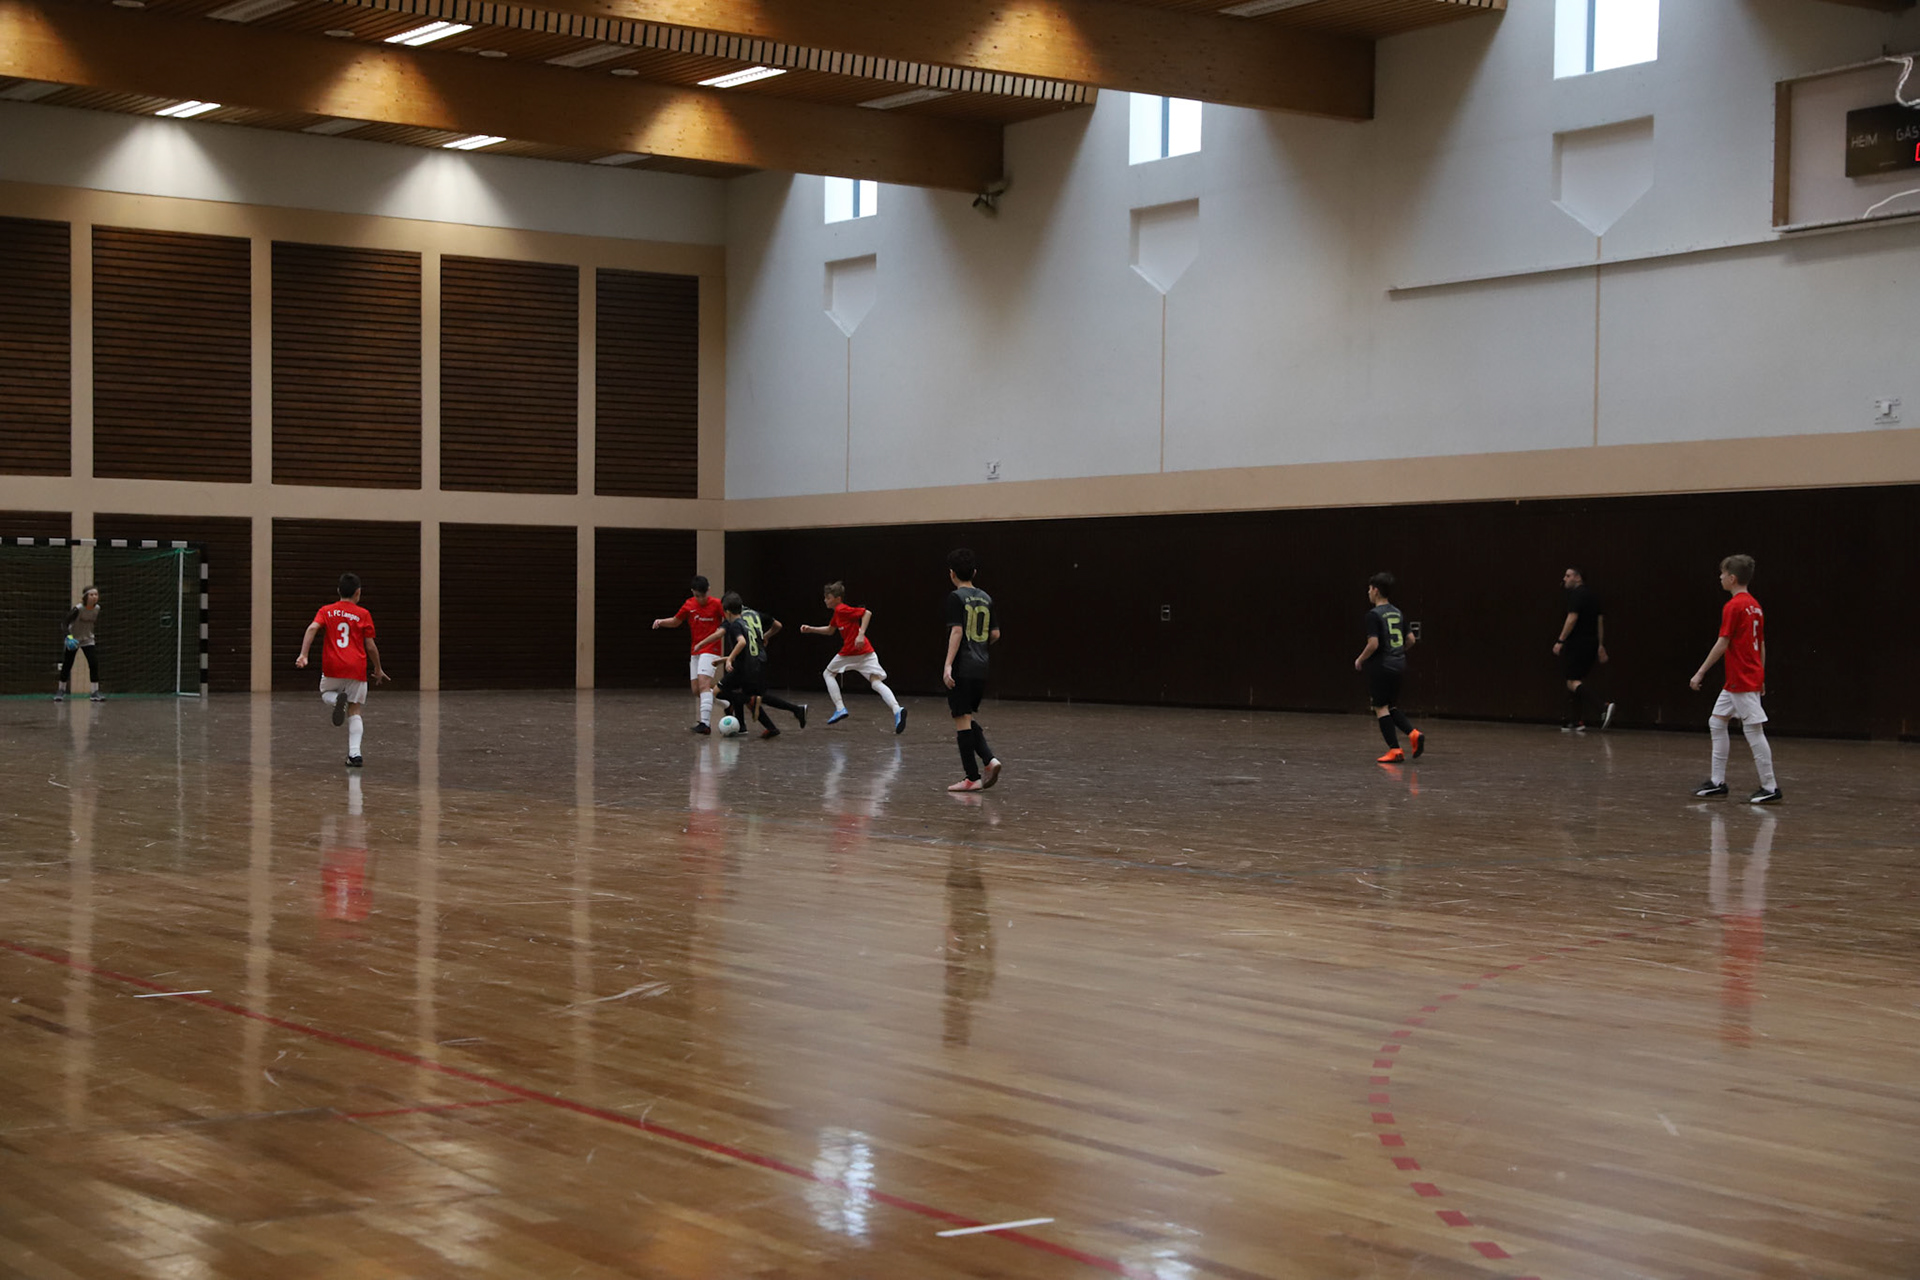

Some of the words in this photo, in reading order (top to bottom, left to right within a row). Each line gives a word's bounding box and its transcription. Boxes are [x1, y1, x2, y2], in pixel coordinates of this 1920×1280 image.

[1851, 132, 1878, 148] HEIM
[1896, 124, 1920, 142] GAS
[333, 609, 341, 617] FC
[964, 603, 990, 642] 10
[336, 622, 350, 648] 3
[1387, 617, 1404, 648] 5
